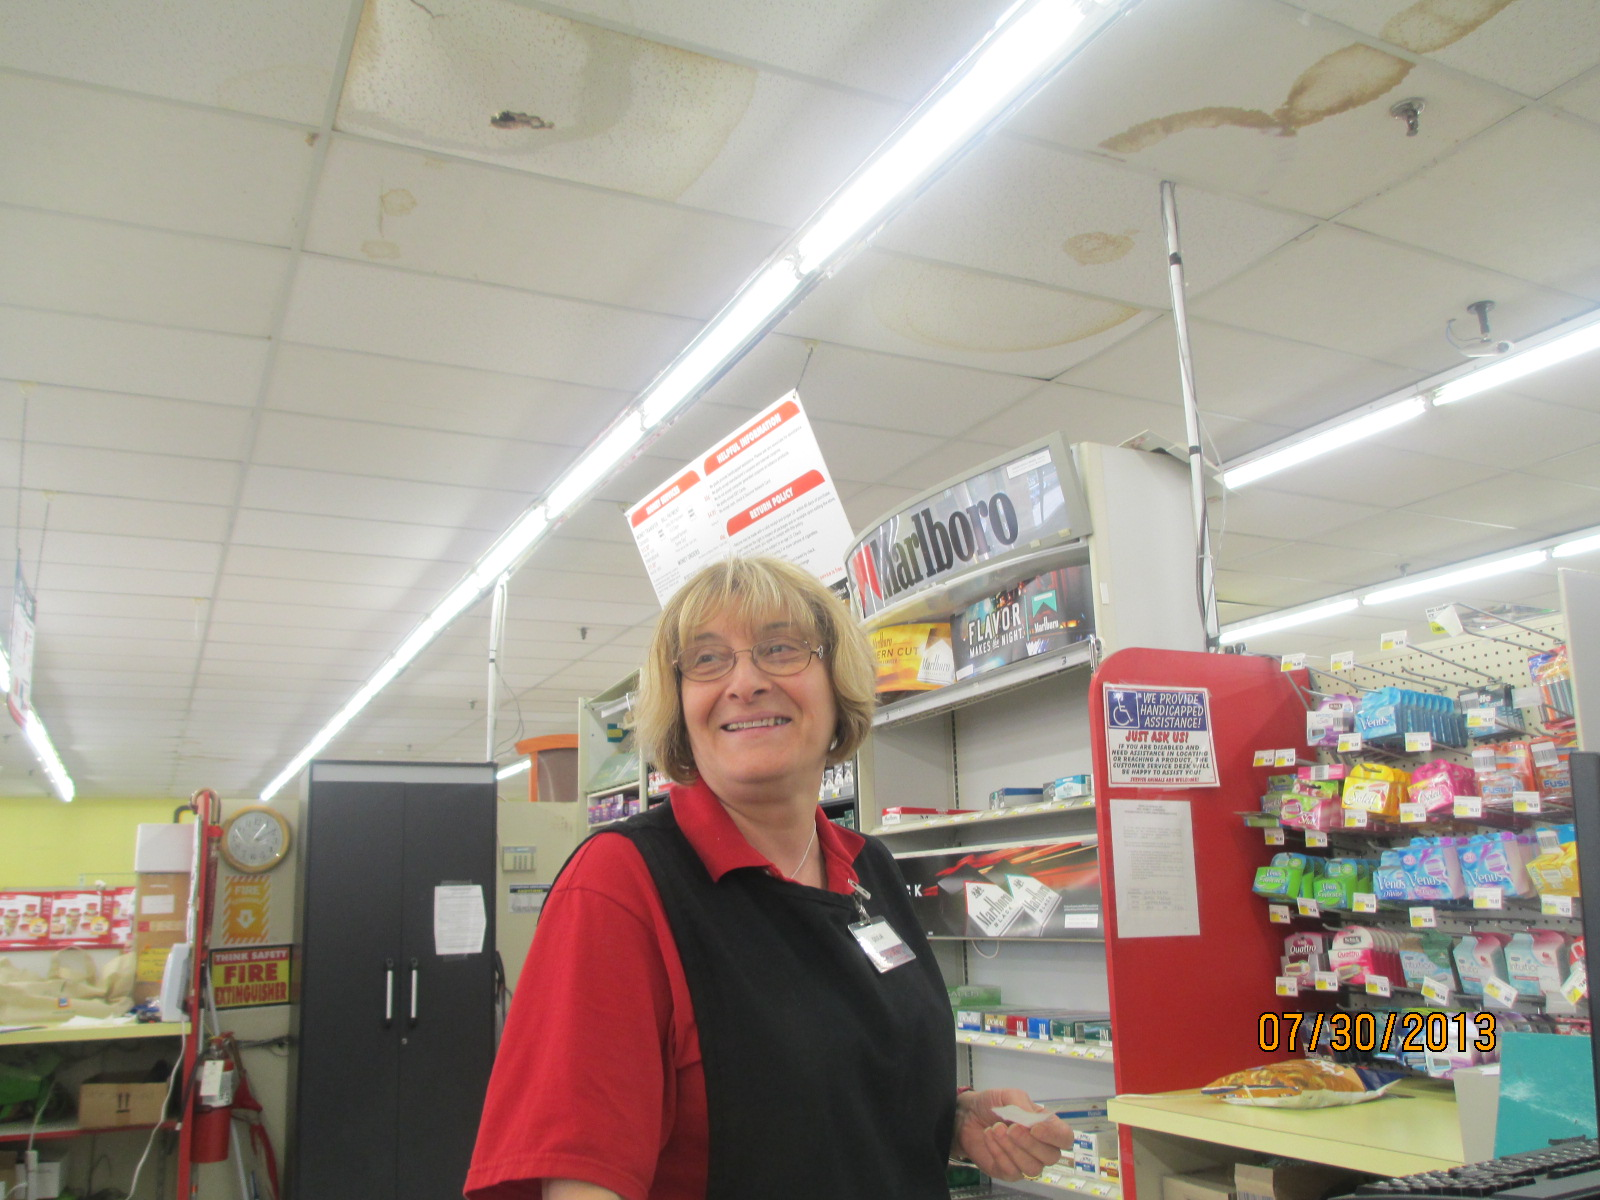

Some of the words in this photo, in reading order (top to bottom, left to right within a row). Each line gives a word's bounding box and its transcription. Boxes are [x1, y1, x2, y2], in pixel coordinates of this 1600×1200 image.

[716, 442, 741, 464] HELPFUL
[739, 412, 782, 448] INFORMATION
[749, 499, 773, 519] RETURN
[771, 487, 794, 507] POLICY
[869, 492, 1018, 601] Marlboro
[969, 602, 1022, 645] FLAVOR
[1034, 615, 1059, 633] Marlboro
[897, 647, 919, 656] CUT
[969, 640, 992, 659] MAKES
[923, 654, 951, 672] Marlboro
[1143, 692, 1157, 704] WE
[1160, 693, 1199, 705] PROVIDE
[1140, 704, 1204, 717] HANDICAPPED
[1144, 717, 1201, 728] ASSISTANCE!
[1361, 716, 1390, 731] Venus
[1125, 730, 1149, 743] JUST
[1151, 732, 1170, 743] ASK
[1173, 732, 1189, 743] US!
[1376, 875, 1406, 890] Venus
[1405, 871, 1442, 888] Venus
[1466, 870, 1503, 887] Venus
[976, 893, 1013, 928] Marlboro
[994, 906, 1012, 928] BLACK
[215, 952, 249, 962] THINK
[251, 950, 287, 959] SAFETY
[1289, 944, 1317, 954] Quattro
[224, 963, 278, 985] FIRE
[214, 982, 287, 1006] EXTINGUISHER
